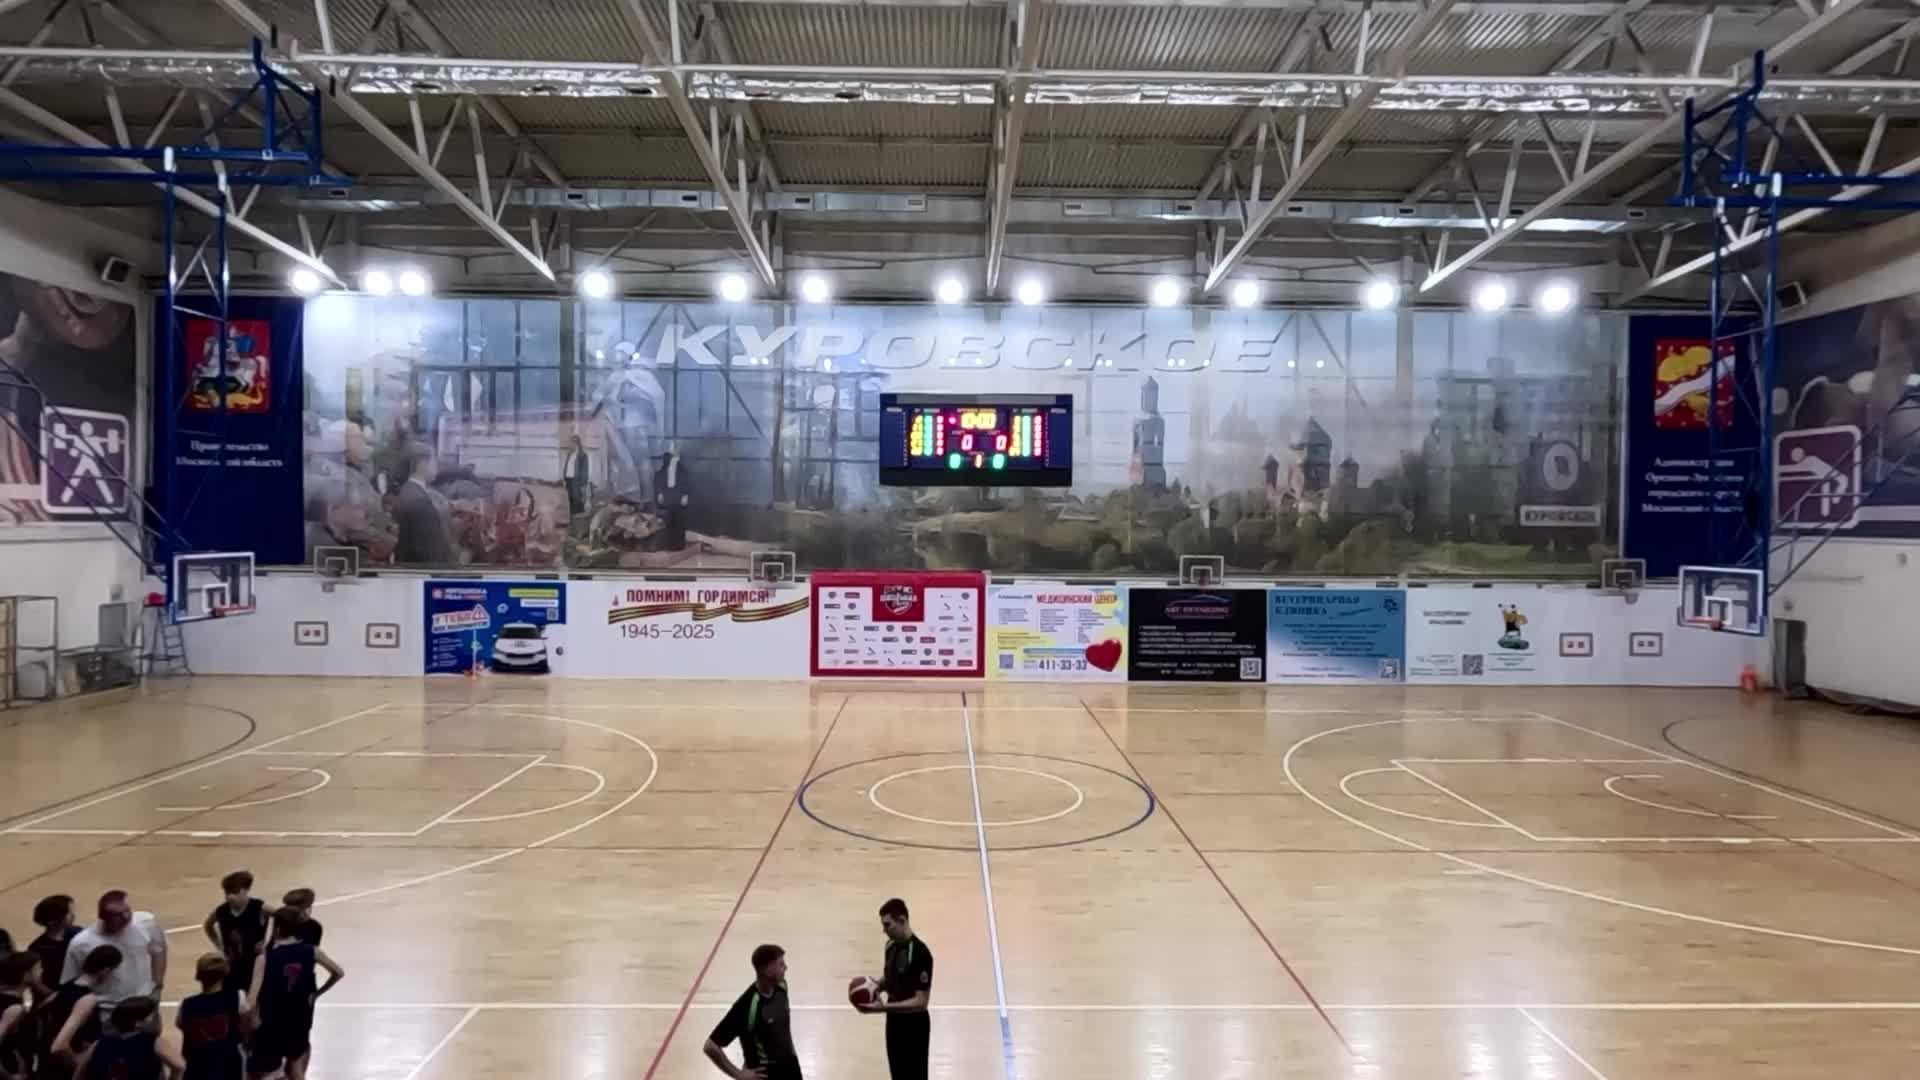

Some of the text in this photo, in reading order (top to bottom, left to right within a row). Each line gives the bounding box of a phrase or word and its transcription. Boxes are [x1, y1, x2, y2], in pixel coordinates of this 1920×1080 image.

[656, 323, 1285, 373] КУРОВСКОЕ
[962, 434, 973, 450] 0
[996, 436, 1007, 451] 0
[626, 588, 771, 605] ПОМНИМ! ГОРДИМСЯ!
[1274, 606, 1328, 616] КЛИНИКА
[1038, 659, 1087, 671] 411-33-33
